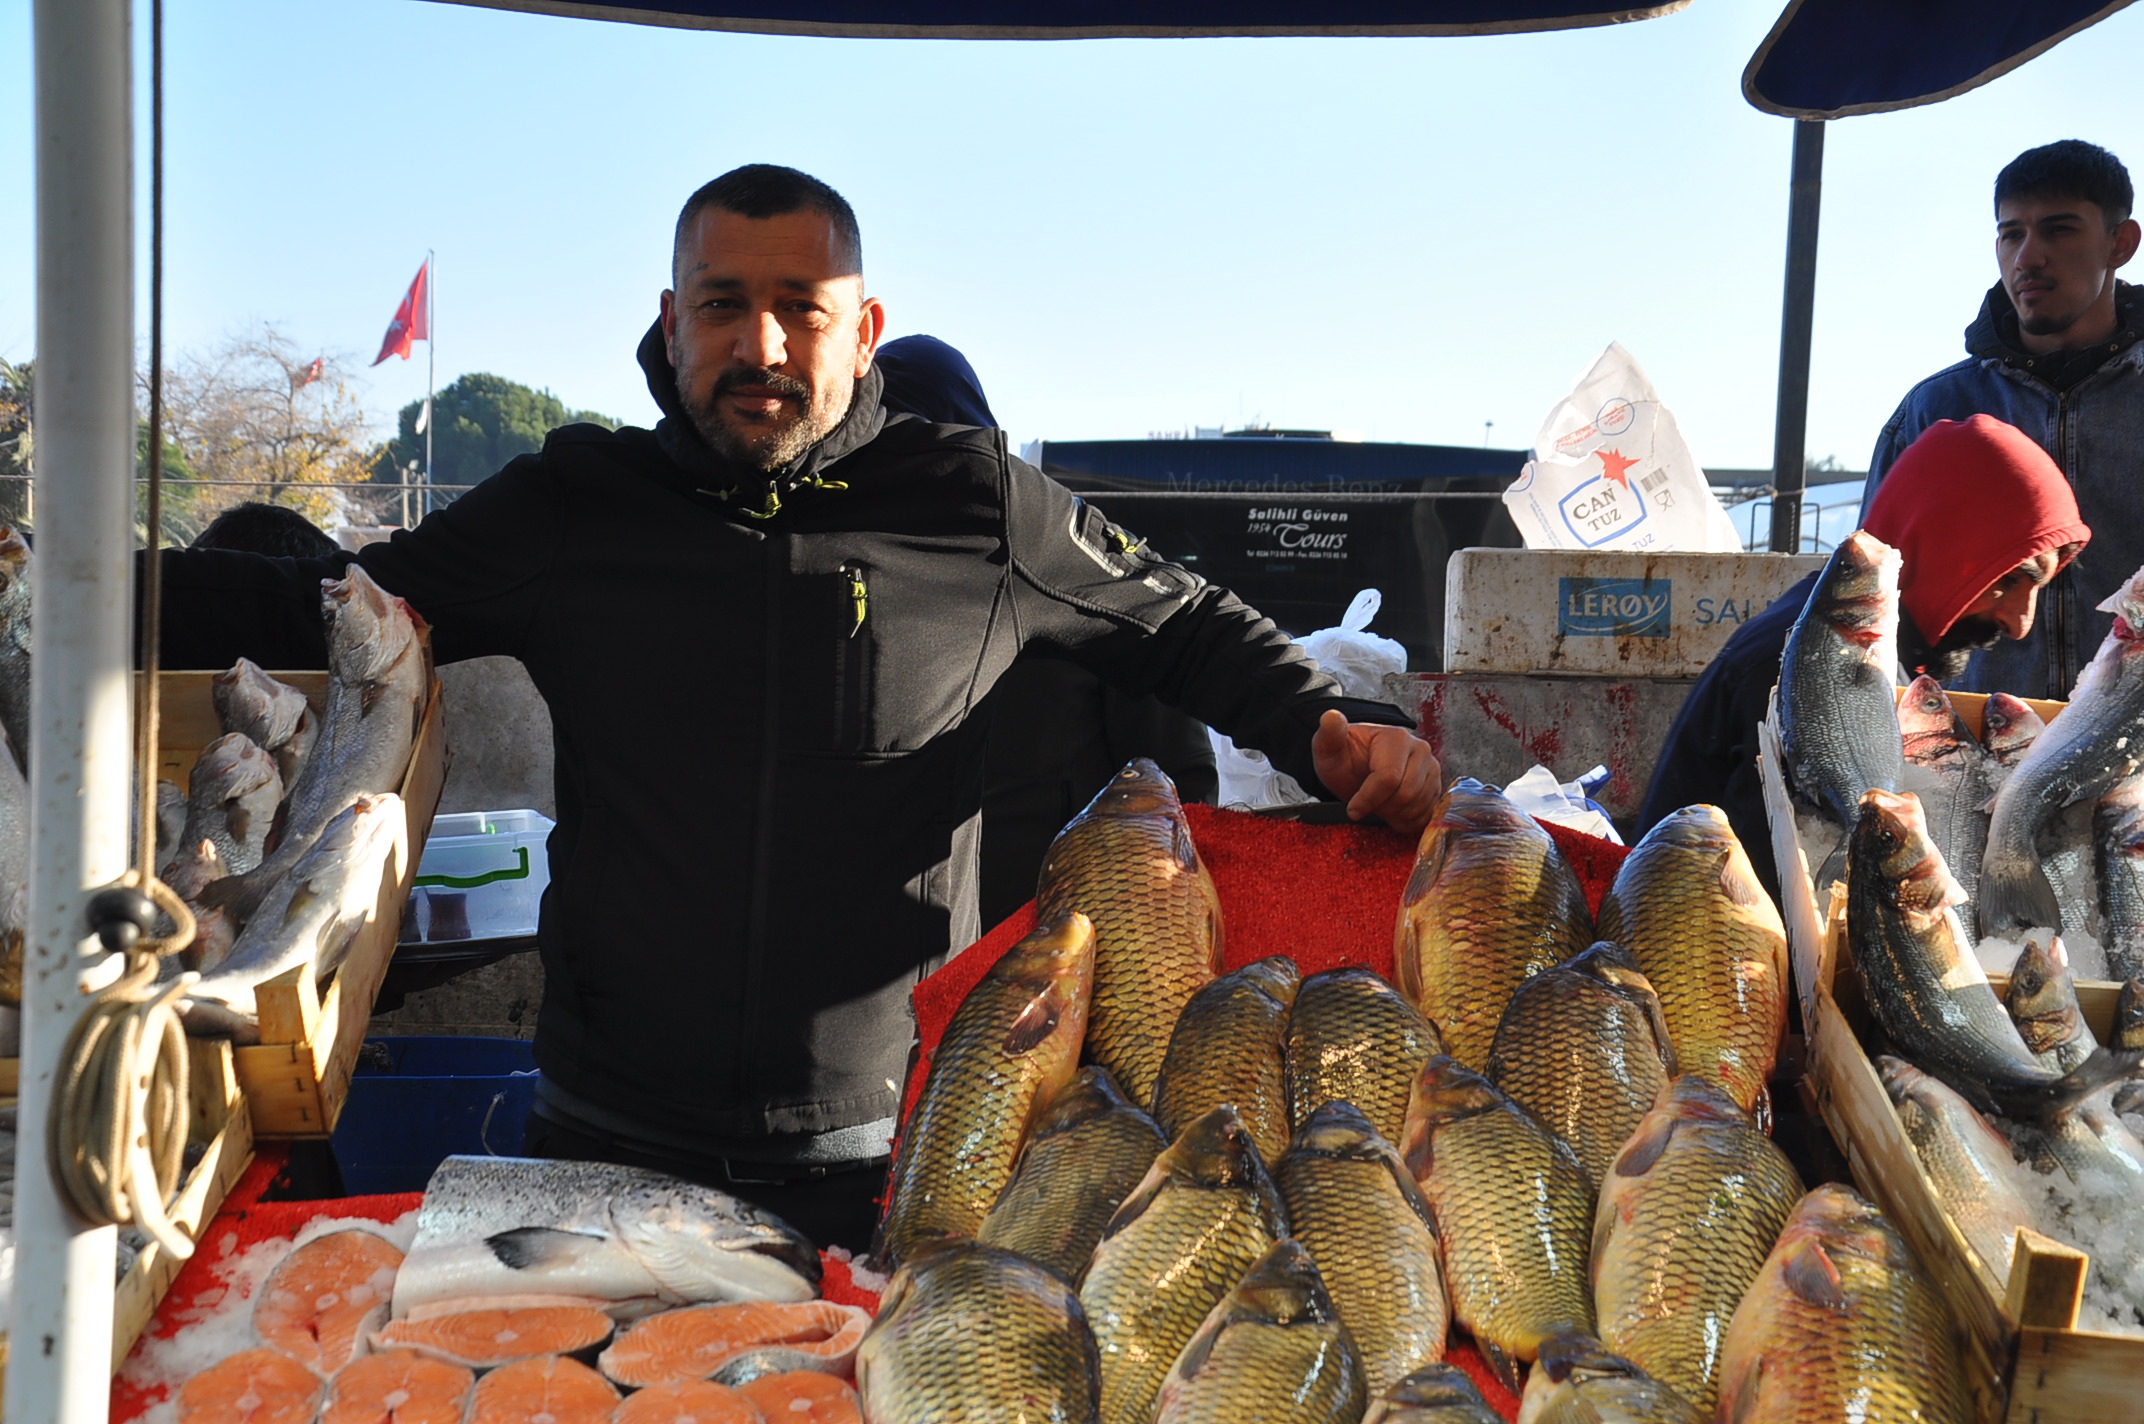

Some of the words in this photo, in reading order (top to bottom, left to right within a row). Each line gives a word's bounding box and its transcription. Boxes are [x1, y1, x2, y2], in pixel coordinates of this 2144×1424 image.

[1166, 471, 1402, 504] Mercedes-Benz
[1248, 507, 1298, 520] Salihli
[1302, 508, 1348, 522] Güven
[1573, 487, 1616, 520] CAN
[1587, 508, 1622, 531] TUZ
[1247, 522, 1272, 533] 1954
[1272, 522, 1347, 549] Tours
[1632, 533, 1656, 550] TUZ
[1568, 592, 1663, 618] LERØY
[1696, 597, 1773, 624] SAL
